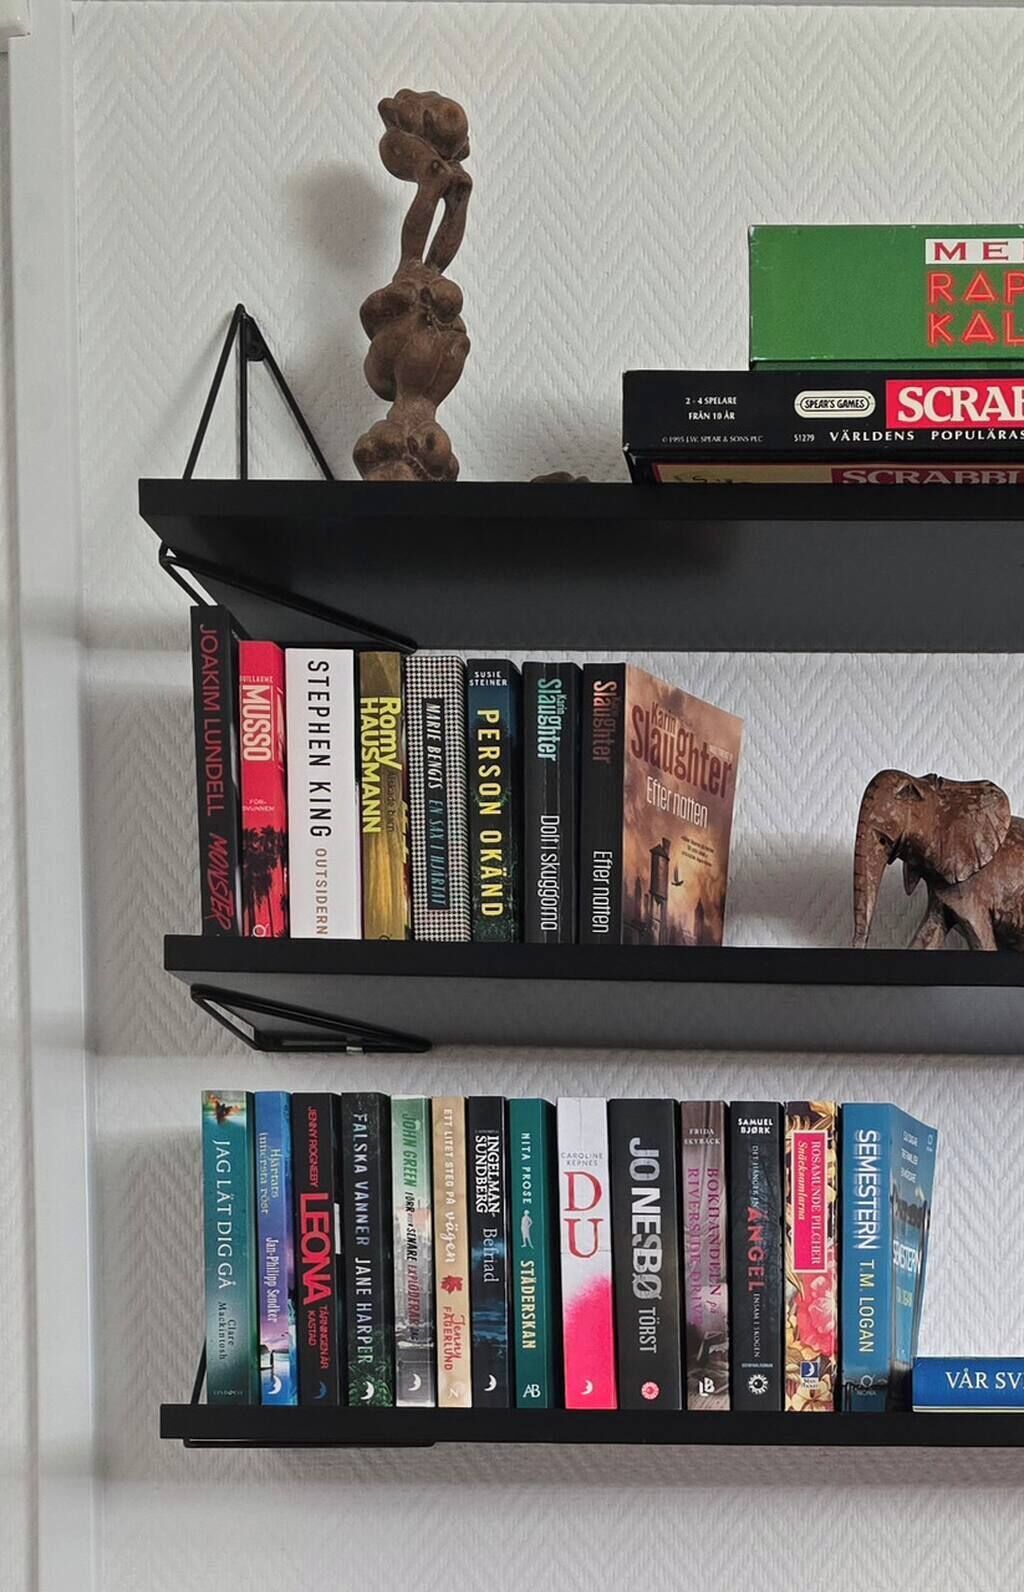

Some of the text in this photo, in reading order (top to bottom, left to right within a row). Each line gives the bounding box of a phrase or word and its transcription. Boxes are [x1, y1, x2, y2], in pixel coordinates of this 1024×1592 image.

[688, 408, 736, 420] FRÅN 10 ÅR
[704, 396, 738, 405] SPELARE
[804, 398, 867, 409] SPEAR'S GAMES
[794, 433, 815, 442] 51279
[829, 429, 916, 442] VÄRLDENS
[469, 679, 508, 687] STEINER
[474, 671, 502, 679] SUSIE
[199, 624, 225, 817] JOAKIM LUNDELL
[242, 685, 273, 762] MUSSO
[379, 697, 403, 771] Romy
[425, 703, 444, 790] MARIE BENGTS
[537, 678, 562, 761] Slaughter
[592, 680, 618, 764] Slaughter
[651, 701, 678, 735] Karin
[307, 660, 332, 838] STEPHEN KING
[360, 697, 382, 834] HAUSMANN
[630, 704, 733, 799] Slaughter
[428, 799, 445, 814] EN
[429, 820, 445, 839] SAX
[477, 709, 508, 916] PERSON OKÄND
[646, 776, 708, 828] Efter natten
[315, 847, 328, 935] OUTSIDERN
[591, 850, 614, 933] Efter natten
[308, 1106, 320, 1188] JENNY ROGNEBY
[352, 1113, 369, 1174] FALSKA
[443, 1108, 453, 1127] ETT
[444, 1131, 454, 1159] LITET
[737, 1118, 774, 1126] SAMUEL
[740, 1126, 771, 1134] BJØRK
[211, 1139, 231, 1174] JAG
[402, 1114, 418, 1188] JOHN GREEN
[445, 1162, 455, 1188] STEG
[474, 1135, 489, 1214] SUNDBERG
[487, 1135, 500, 1218] INGELMAN-
[521, 1132, 533, 1205] NITA PROSE
[629, 1136, 663, 1300] JO NESBØ
[687, 1168, 702, 1264] RIVERSIDE
[811, 1140, 823, 1265] ROSAMUNDE PILCHER
[857, 1129, 879, 1250] SEMESTERN
[217, 1221, 233, 1257] DIG
[300, 1192, 333, 1305] LEONA
[406, 1227, 418, 1262] SENARE
[482, 1228, 500, 1283] Befriad
[707, 1168, 722, 1296] BOKHANDELN
[217, 1263, 237, 1289] GÅ
[264, 1236, 281, 1323] Jan-Philipp Sendker
[407, 1264, 421, 1325] EXPLODERAR
[520, 1260, 537, 1349] STÄDERSKAN
[218, 1301, 229, 1360] Mackintosh
[227, 1318, 238, 1346] Clare
[307, 1310, 317, 1346] KASTAD
[355, 1257, 374, 1364] JANE HARPER
[452, 1314, 466, 1359] Jenny
[638, 1306, 660, 1354] TÖRST
[858, 1297, 875, 1353] LOGAN
[944, 1367, 989, 1390] VÅR
